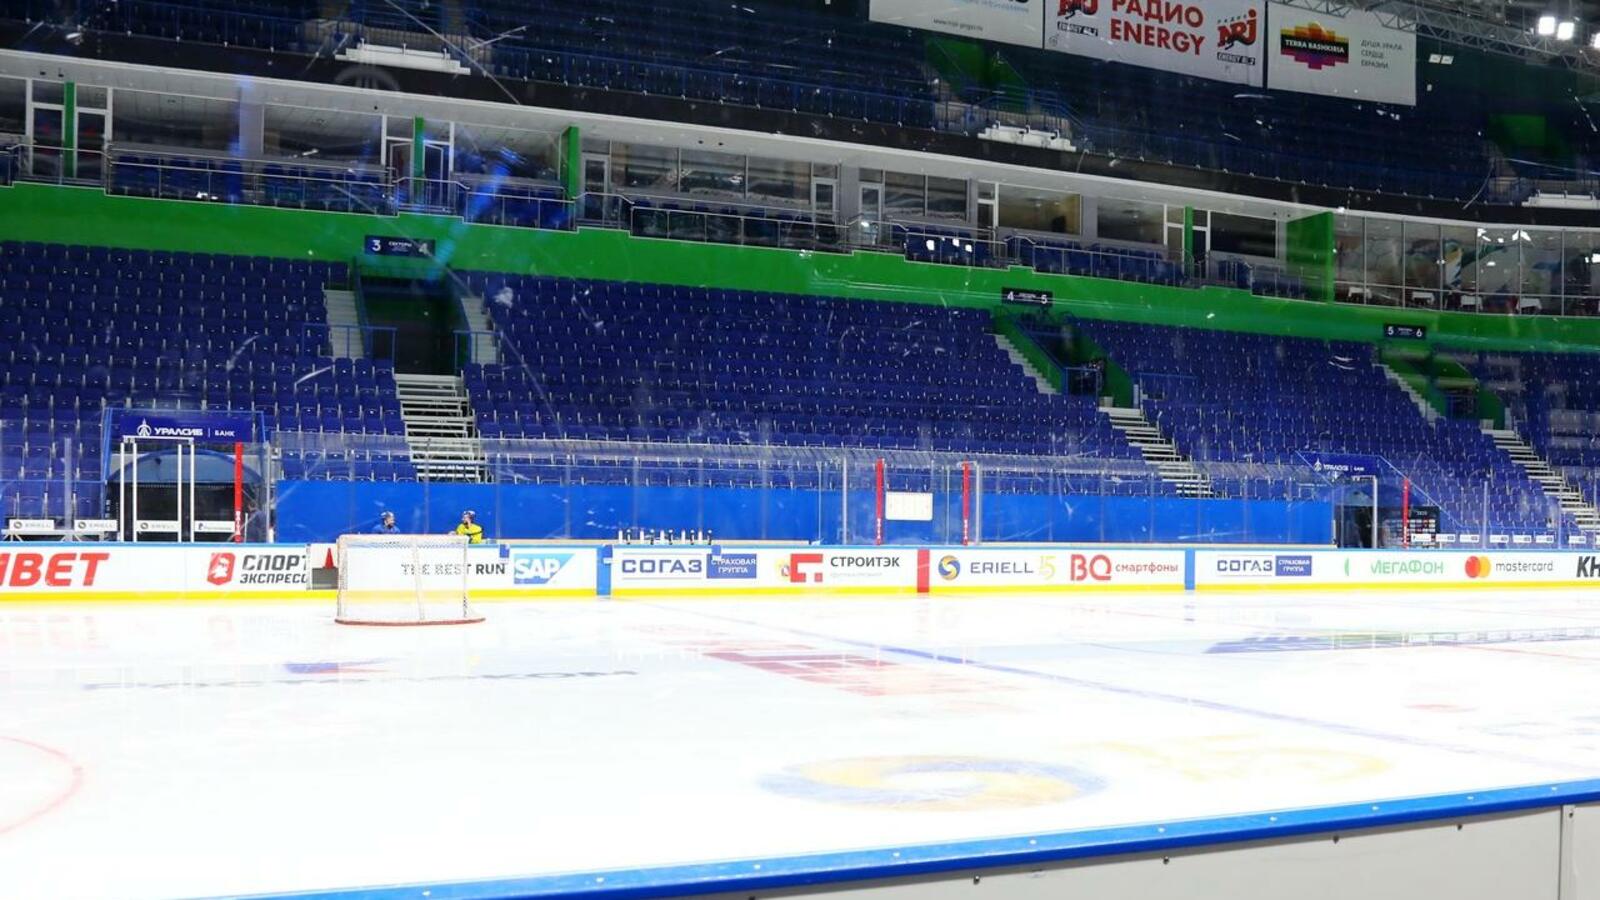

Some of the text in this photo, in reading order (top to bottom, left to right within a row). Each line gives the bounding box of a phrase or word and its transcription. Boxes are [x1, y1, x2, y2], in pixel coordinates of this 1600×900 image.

[1112, 0, 1204, 28] РАДИО
[1110, 18, 1205, 56] ENERGY
[1285, 39, 1345, 53] TERRA BASHKIRIA
[372, 239, 381, 252] 3
[1007, 291, 1014, 301] 4
[1041, 294, 1048, 304] 5
[1388, 326, 1394, 335] 5
[154, 427, 235, 437] УРАЛСИБ БАНК
[621, 559, 703, 573] СОГАЗ
[711, 557, 757, 566] СТРАХОВАЯ
[830, 556, 901, 568] СТРОИТЭК
[970, 561, 1034, 574] ERIELL
[1070, 554, 1179, 581] BQ смартфоны
[1217, 560, 1273, 572] СОГАЗ
[1495, 560, 1554, 572] mastercard
[476, 563, 506, 575] RUN
[515, 557, 562, 580] SAP
[718, 566, 749, 574] ГРУППА
